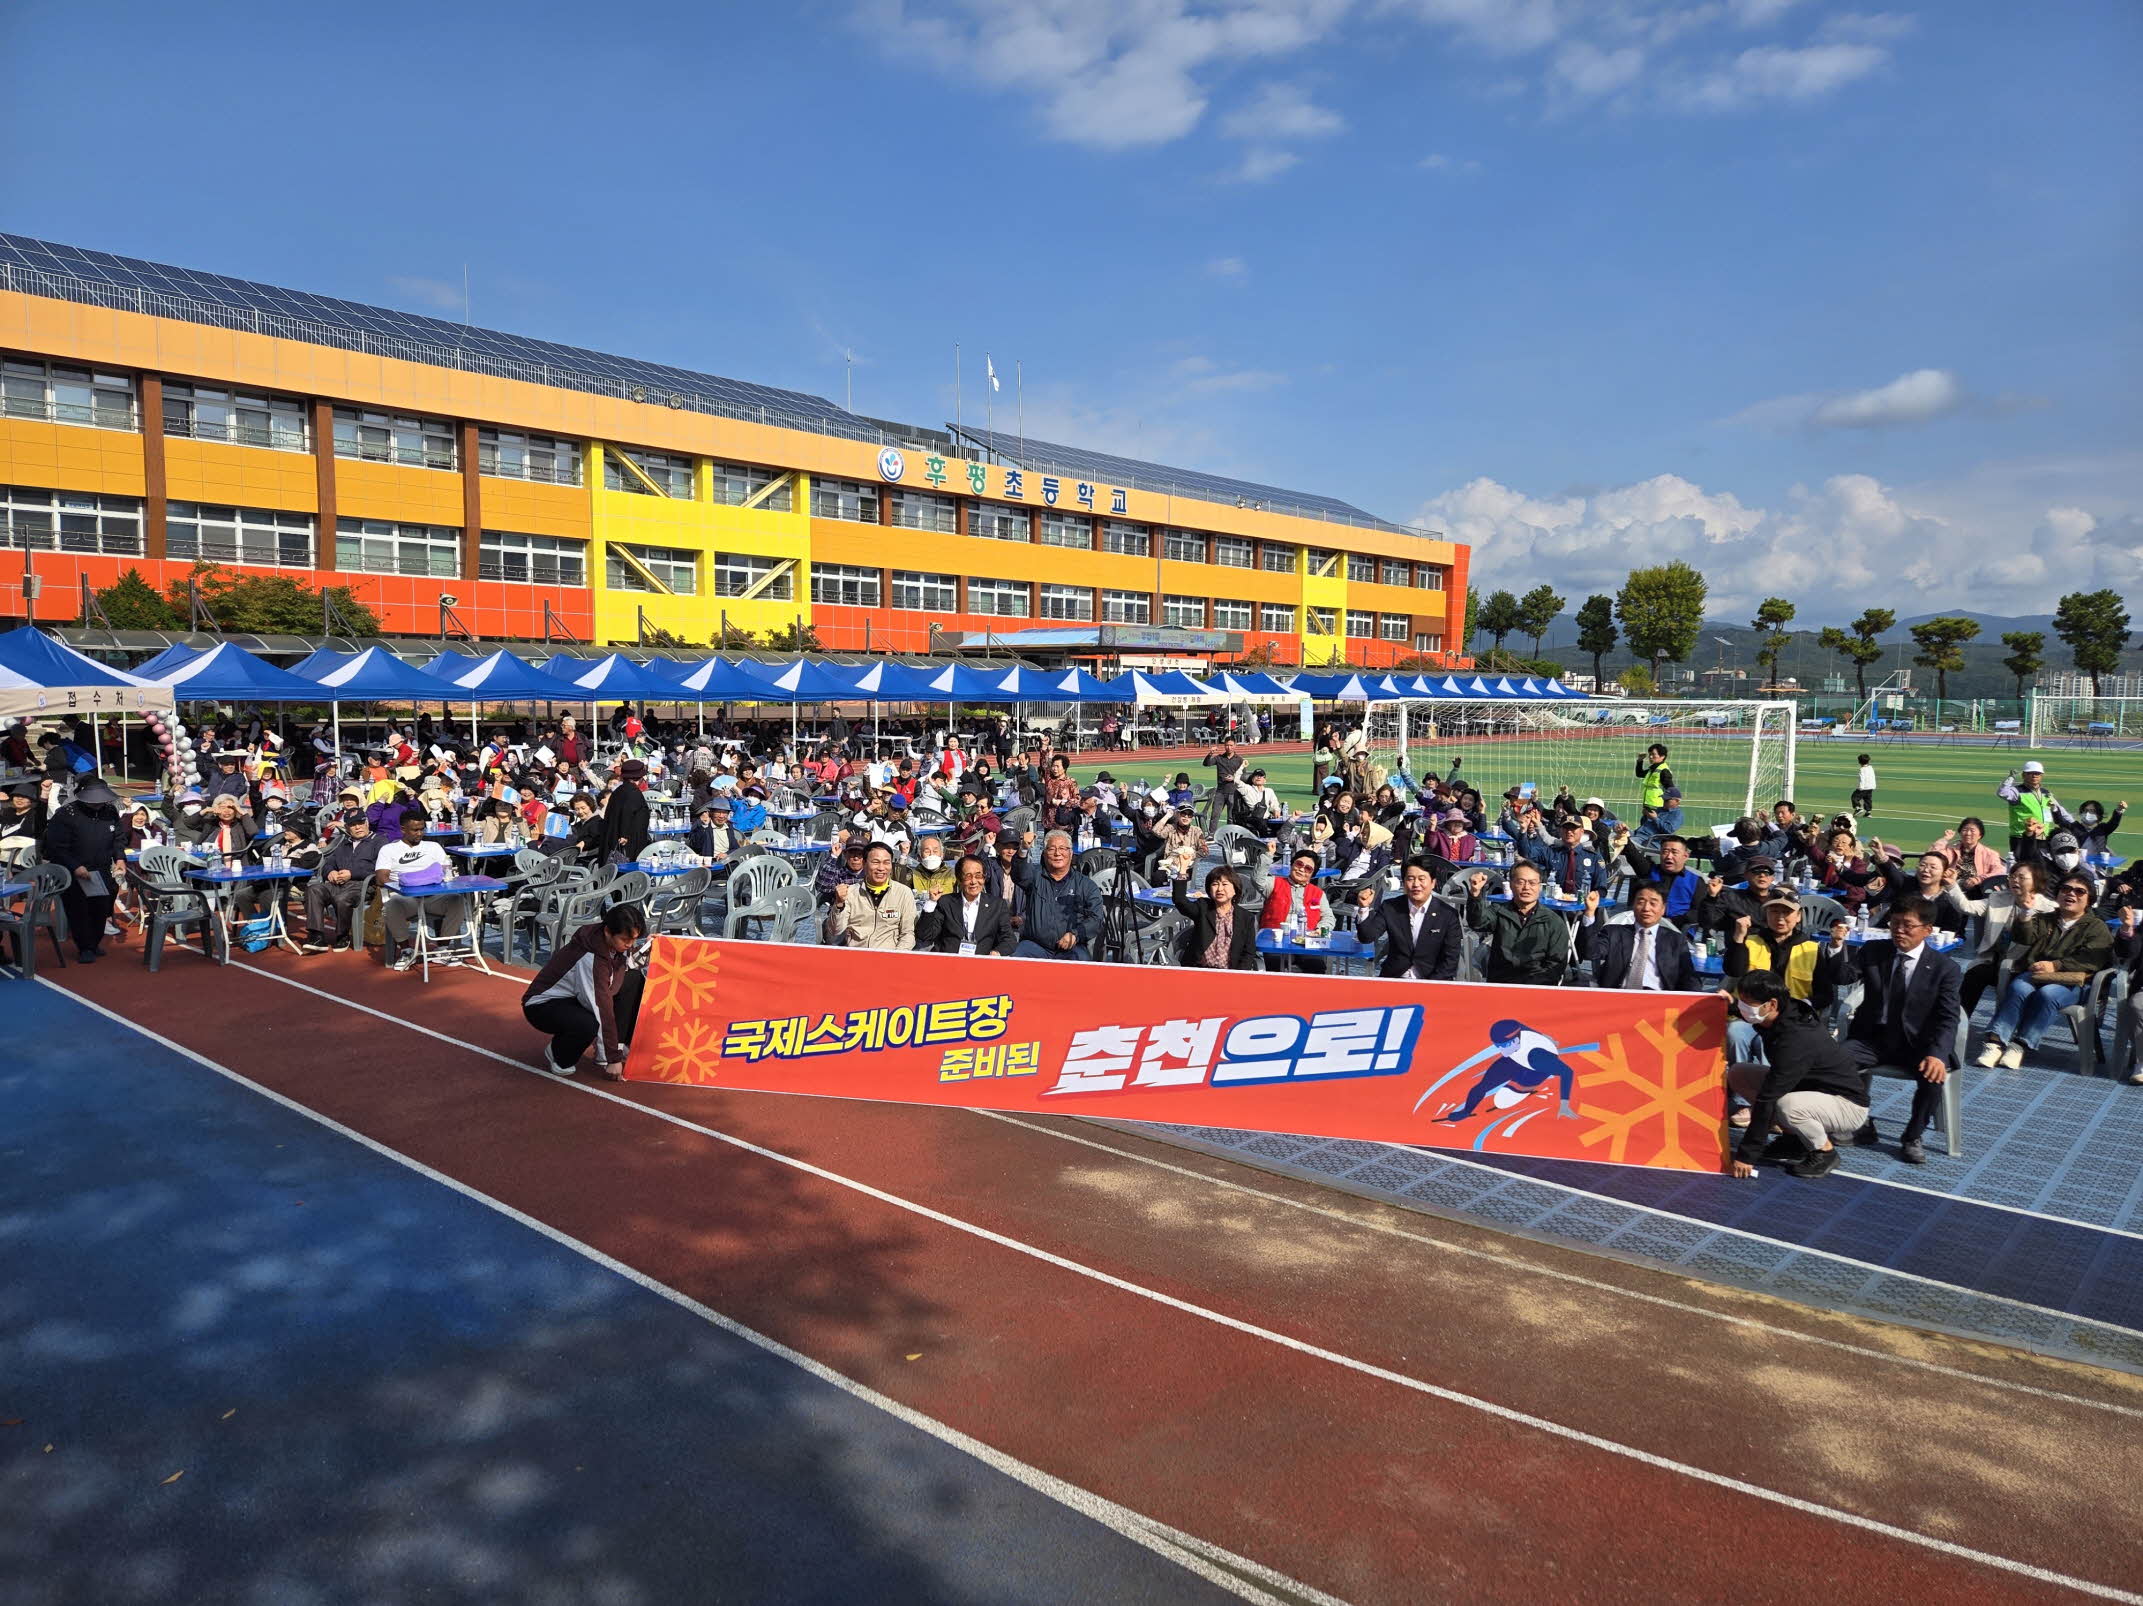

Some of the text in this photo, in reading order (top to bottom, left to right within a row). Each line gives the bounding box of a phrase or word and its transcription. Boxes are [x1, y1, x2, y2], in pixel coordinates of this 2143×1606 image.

[925, 457, 1126, 514] 후평초등학교
[67, 690, 123, 707] 접수처
[722, 994, 1012, 1062] 국제스케이트장
[1041, 1005, 1424, 1096] 춘천으로!
[938, 1041, 1041, 1083] 준비된
